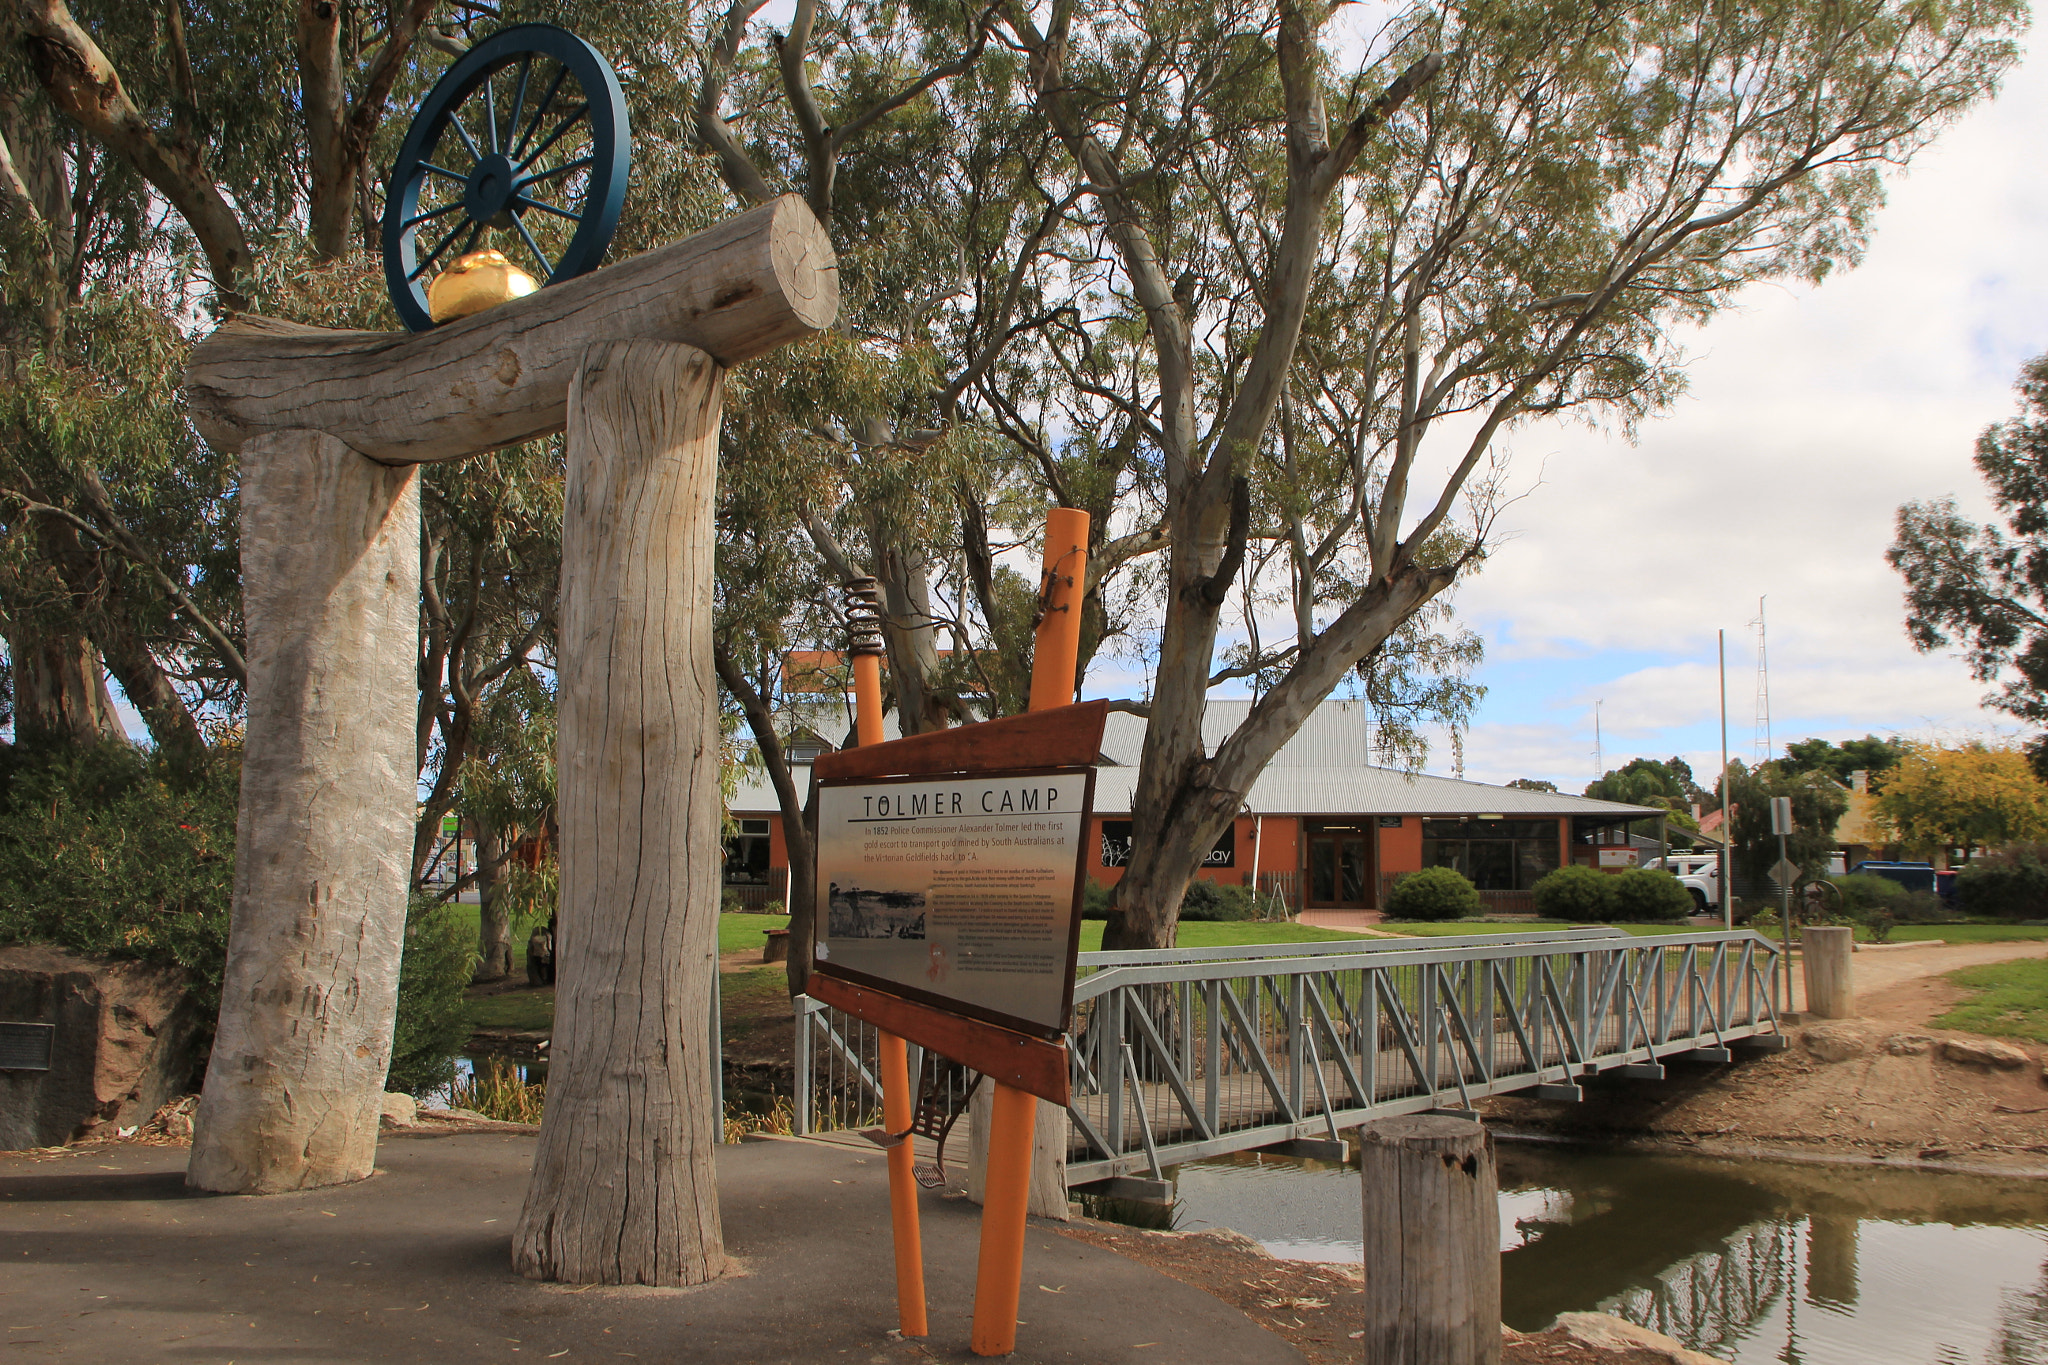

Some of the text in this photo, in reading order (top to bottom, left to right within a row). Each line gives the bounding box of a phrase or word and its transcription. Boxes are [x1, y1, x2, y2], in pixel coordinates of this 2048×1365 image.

[863, 787, 1058, 817] TOLMER CAMP
[865, 820, 1063, 835] In 1852 Police Commissioner Alexander Tolmer led the first
[864, 840, 879, 851] gold
[880, 840, 899, 849] escort
[909, 840, 940, 850] transport
[941, 838, 956, 849] gold
[958, 838, 979, 847] mined
[981, 838, 990, 848] by
[991, 836, 1012, 846] South
[1013, 835, 1055, 846] Australians
[1056, 836, 1065, 845] at
[864, 853, 875, 862] the
[905, 852, 939, 862] Goldfields
[958, 853, 966, 861] to
